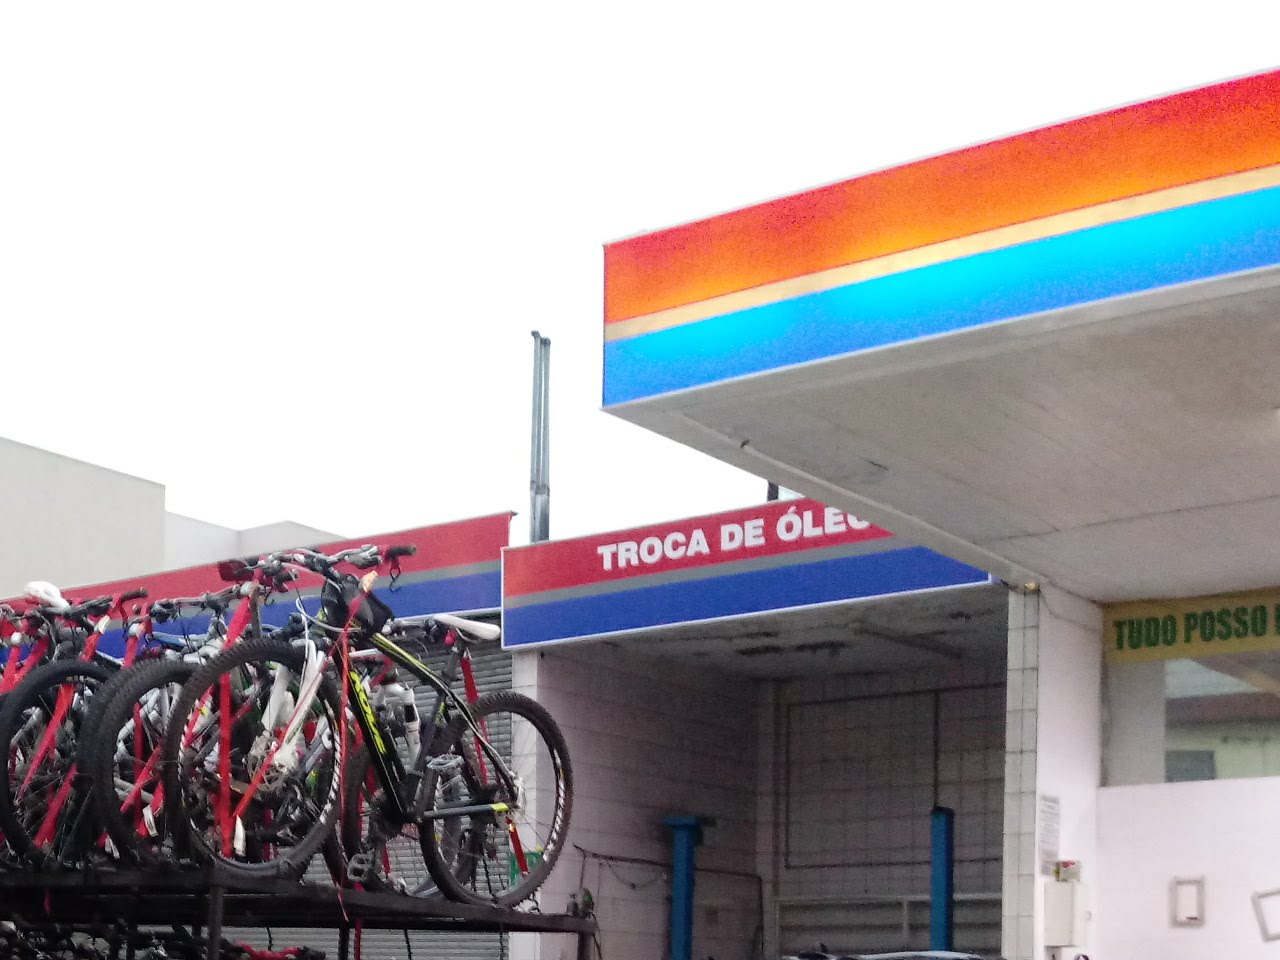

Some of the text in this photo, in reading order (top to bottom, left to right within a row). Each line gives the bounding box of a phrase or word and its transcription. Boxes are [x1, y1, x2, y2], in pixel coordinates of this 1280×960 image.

[597, 528, 710, 571] TROCA
[720, 518, 765, 550] DE
[1113, 614, 1177, 650] TUDO
[1184, 605, 1268, 643] POSSO
